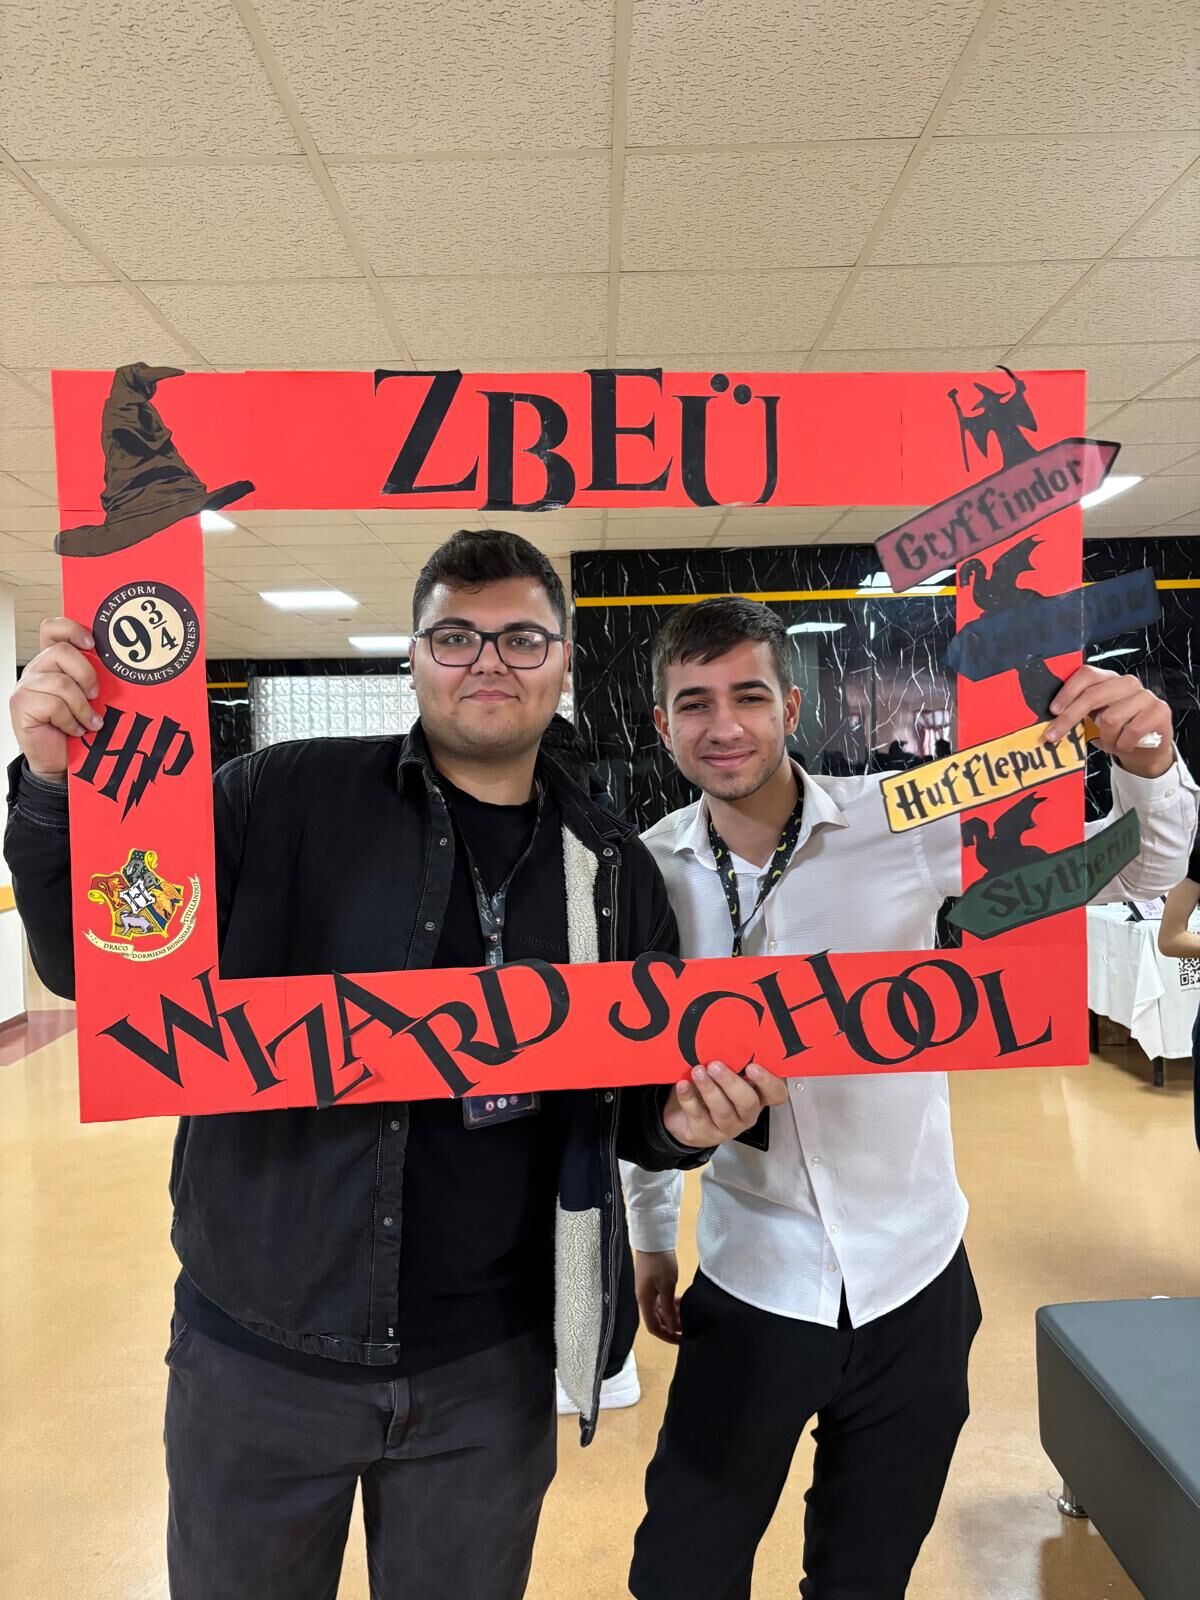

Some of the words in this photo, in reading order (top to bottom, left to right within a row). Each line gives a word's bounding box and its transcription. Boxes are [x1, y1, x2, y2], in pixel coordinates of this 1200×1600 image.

[374, 367, 781, 512] ZBEÜ
[893, 456, 1084, 572] Gryffindor
[100, 585, 157, 623] PLATFORM
[112, 661, 174, 682] HOGWARTS
[174, 620, 197, 670] EXPRESS
[980, 826, 1134, 918] Slytherin
[103, 943, 129, 952] DRACO
[131, 948, 167, 959] DORMIENS
[96, 957, 570, 1110] WIZARD
[608, 948, 1053, 1077] SCHOOL
